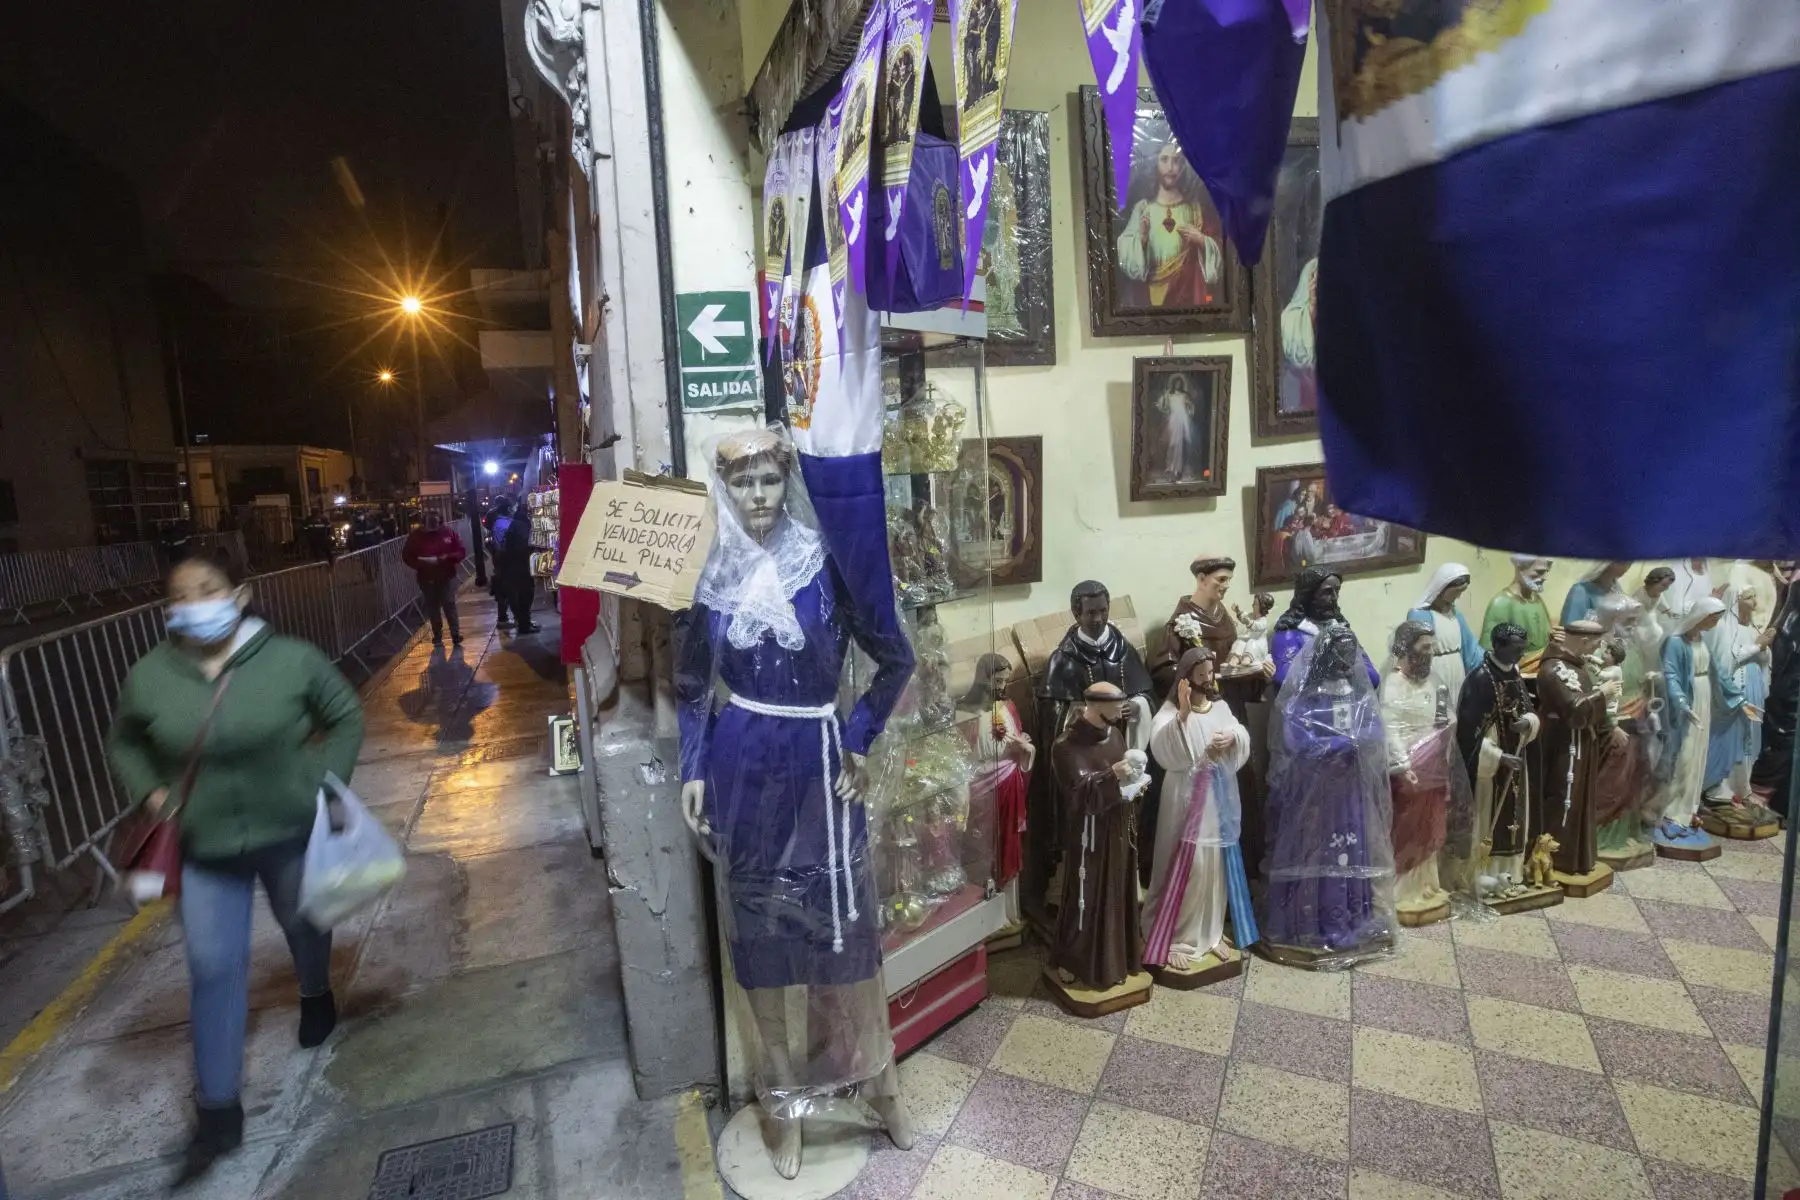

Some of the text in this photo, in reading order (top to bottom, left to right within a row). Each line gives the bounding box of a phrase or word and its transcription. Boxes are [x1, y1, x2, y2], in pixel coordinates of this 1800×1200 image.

[687, 380, 754, 398] SALIDA
[606, 500, 702, 531] SE SOLICITA
[602, 522, 696, 554] VENDEDOR(A)
[593, 541, 685, 575] FULL PILAS
